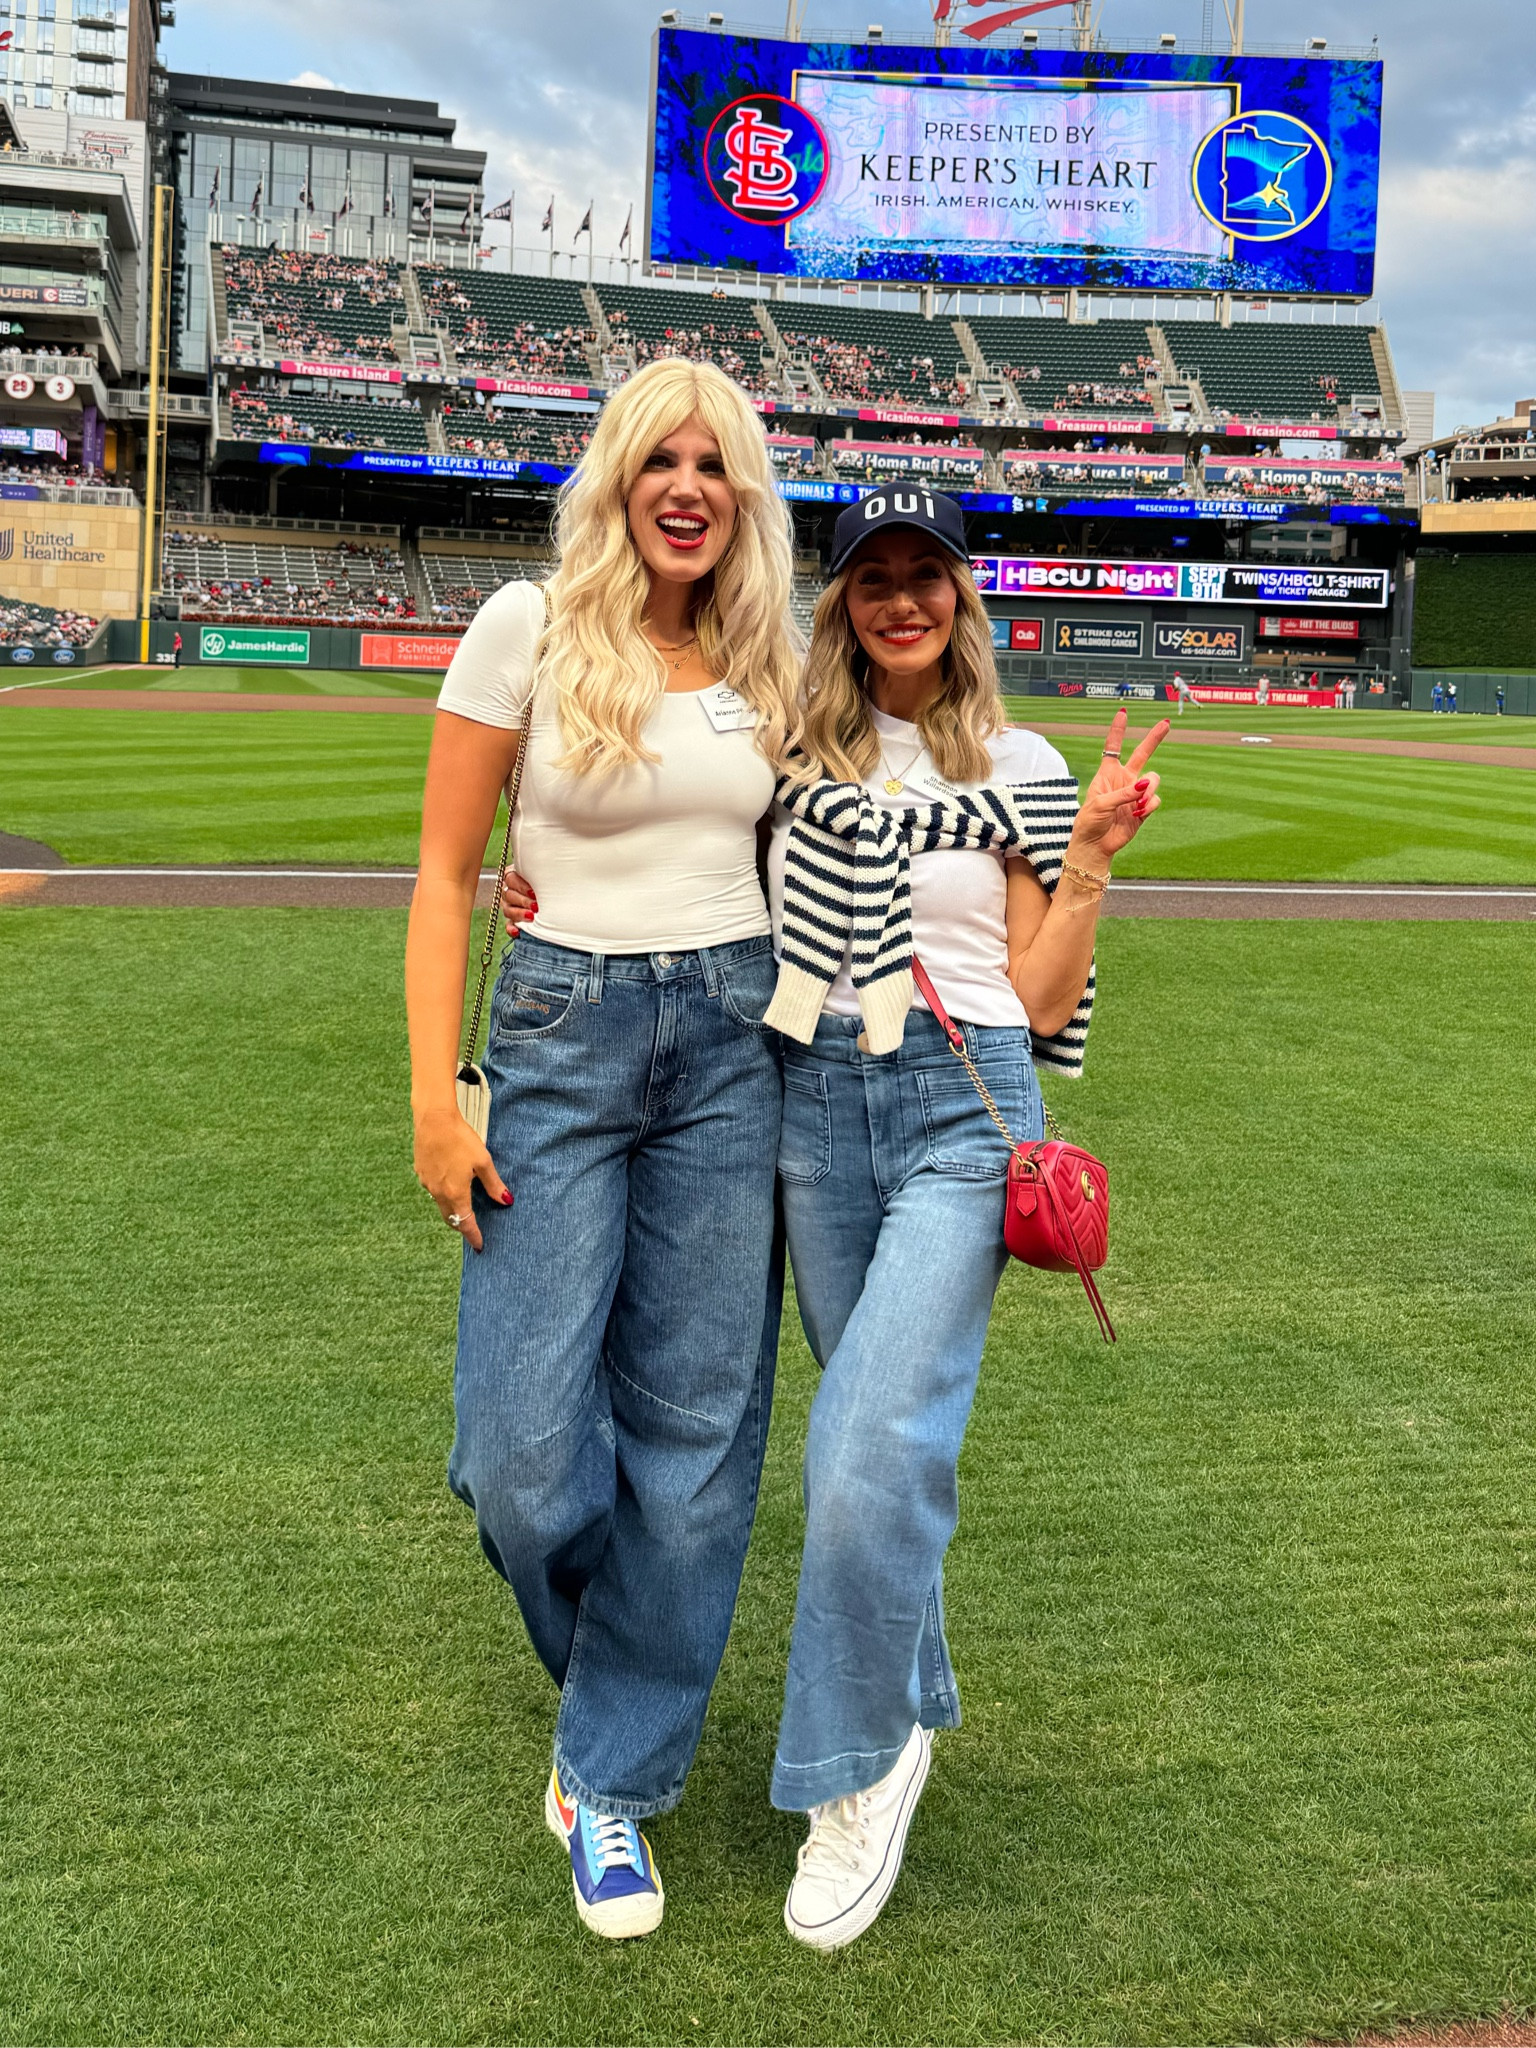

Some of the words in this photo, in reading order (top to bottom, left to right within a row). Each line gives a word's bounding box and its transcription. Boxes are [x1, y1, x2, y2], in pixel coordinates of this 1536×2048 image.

[924, 122, 1058, 144] PRESENTED
[1065, 126, 1095, 145] BY
[860, 153, 1018, 185] KEEPER'S
[1037, 159, 1158, 189] HEART
[874, 194, 930, 207] IRISH.
[936, 195, 1040, 210] AMERICAN.
[1046, 198, 1135, 213] WHISKEY.
[0, 287, 38, 300] UER!
[294, 362, 350, 377] Treasure
[352, 368, 390, 382] Island
[12, 380, 28, 392] 29
[56, 382, 64, 394] 3
[1055, 420, 1105, 432] Treasure
[1107, 421, 1142, 433] Island
[364, 456, 411, 468] PRESENTED
[412, 459, 423, 468] BY
[483, 460, 521, 473] HEART
[866, 454, 909, 469] Home
[1260, 470, 1307, 484] Home
[1311, 471, 1342, 485] Run
[776, 482, 835, 500] ARDINALS
[1135, 504, 1178, 513] PRESENTED
[1180, 505, 1190, 513] BY
[1247, 503, 1285, 515] HEART
[23, 530, 74, 546] United
[23, 545, 106, 562] Healthcare
[1005, 567, 1091, 587] HBCU
[1097, 568, 1174, 592] Night
[1189, 566, 1228, 584] SEPT
[1233, 572, 1323, 588] TWINS/HBCU
[1326, 575, 1382, 589] T-SHIRT
[1192, 583, 1223, 599] 9TH
[1278, 587, 1306, 596] TICKET
[1307, 588, 1349, 598] PACKAGE)
[1300, 620, 1313, 629] HIT
[1314, 620, 1330, 630] THE
[1331, 621, 1354, 631] BUDS
[1016, 629, 1036, 640] Cub
[1073, 628, 1113, 638] STRIKE
[1114, 630, 1138, 639] OUT
[228, 640, 306, 653] JamesHardie
[1073, 638, 1111, 647] CHILDHOOD
[1111, 639, 1138, 648] CANCER
[1181, 647, 1237, 656] us-solar.com
[1190, 690, 1212, 699] TTING
[1212, 691, 1234, 700] MORE
[1235, 692, 1253, 701] KIDS
[1272, 693, 1286, 702] THE
[1287, 694, 1308, 703] GAME
[930, 776, 958, 794] Shannon
